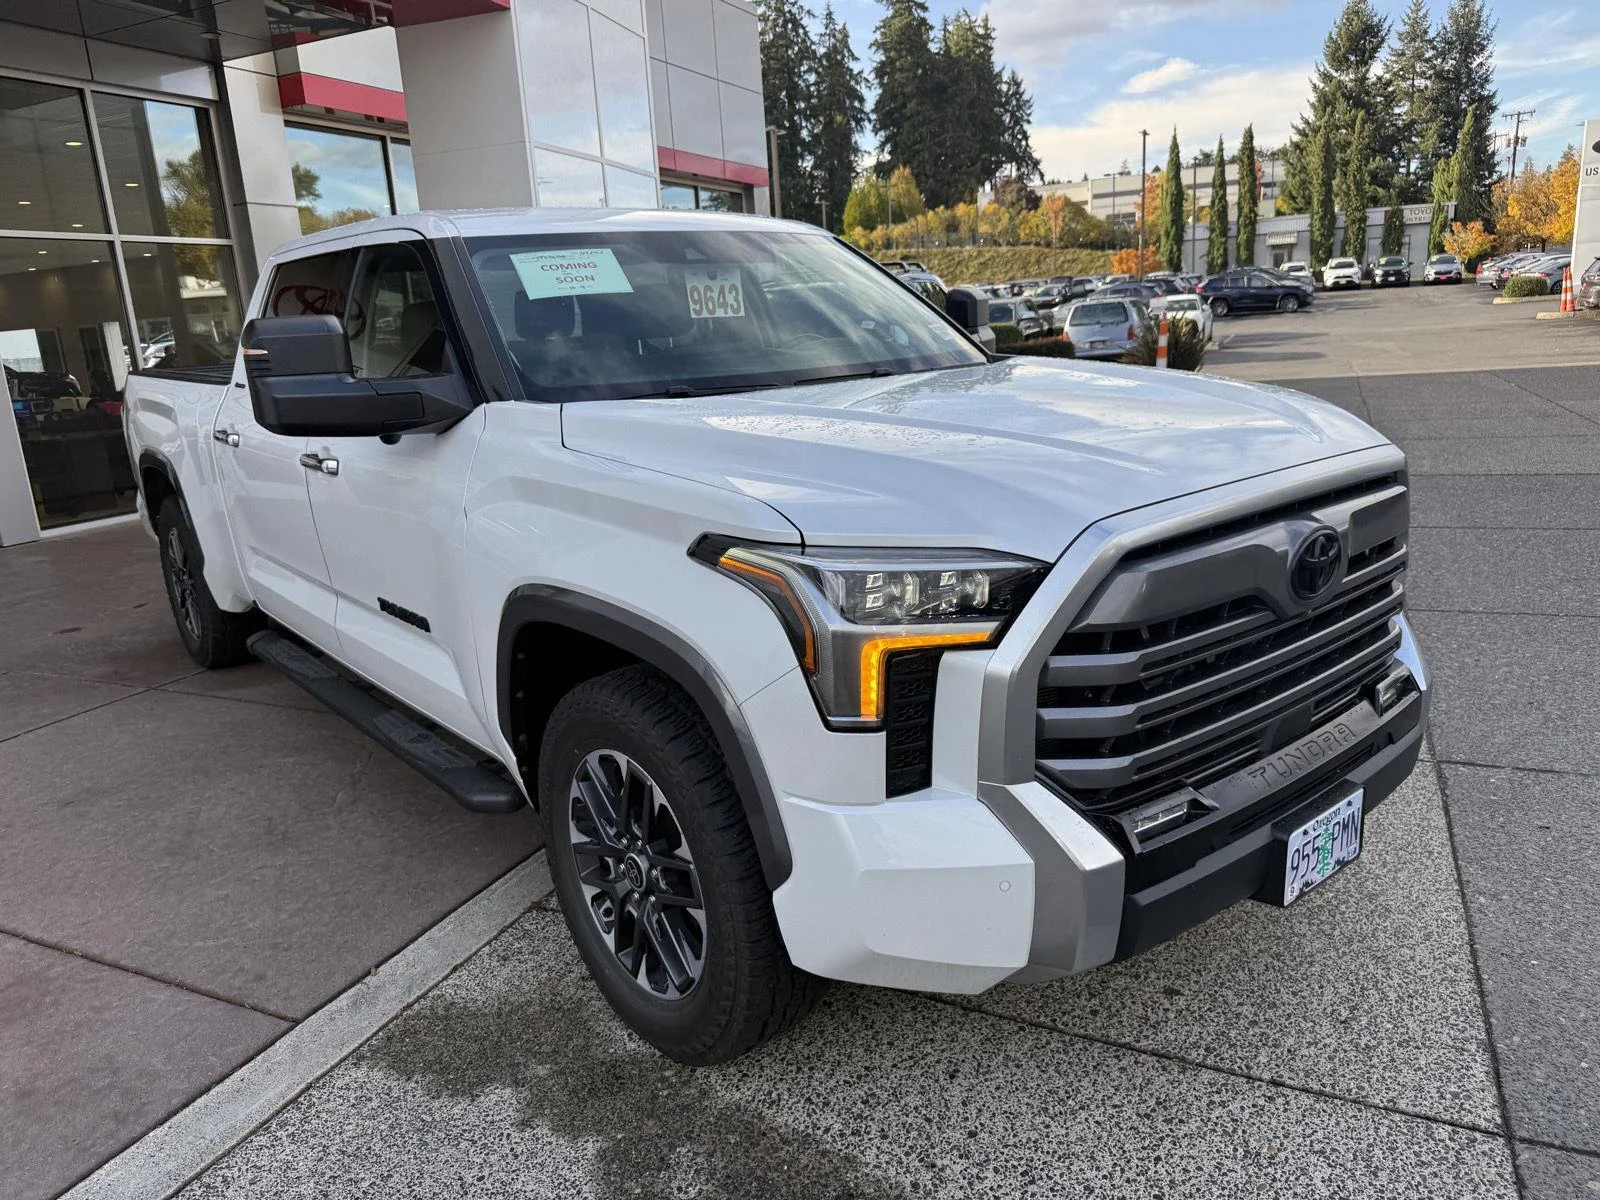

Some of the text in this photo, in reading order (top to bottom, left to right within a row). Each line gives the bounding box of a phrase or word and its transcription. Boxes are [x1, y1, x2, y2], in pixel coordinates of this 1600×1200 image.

[540, 261, 598, 272] COMING
[555, 274, 596, 284] SOON
[689, 283, 742, 317] 9643
[1248, 722, 1356, 788] TUNDRA
[1312, 807, 1341, 832] Oregon
[1290, 806, 1361, 886] 955 PMN
